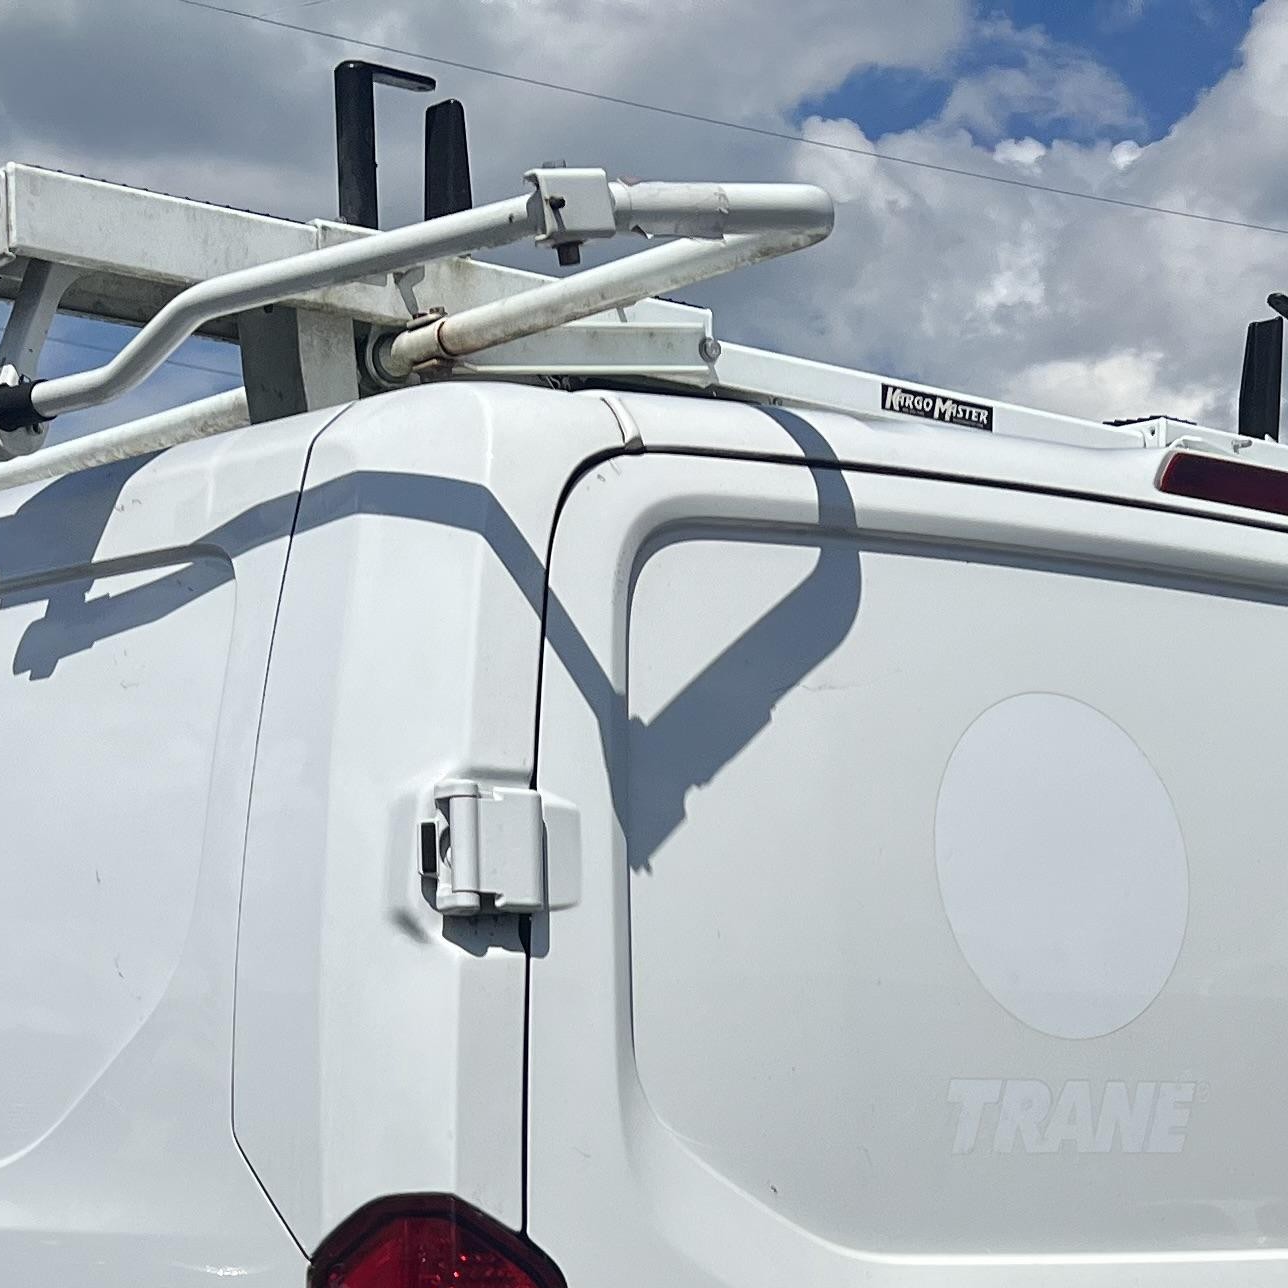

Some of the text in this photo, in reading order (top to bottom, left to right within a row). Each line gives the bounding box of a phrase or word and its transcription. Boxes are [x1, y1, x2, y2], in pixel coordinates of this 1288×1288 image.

[886, 388, 933, 411] KARGO
[934, 397, 988, 423] MASTER
[947, 1078, 1197, 1154] TRANE
